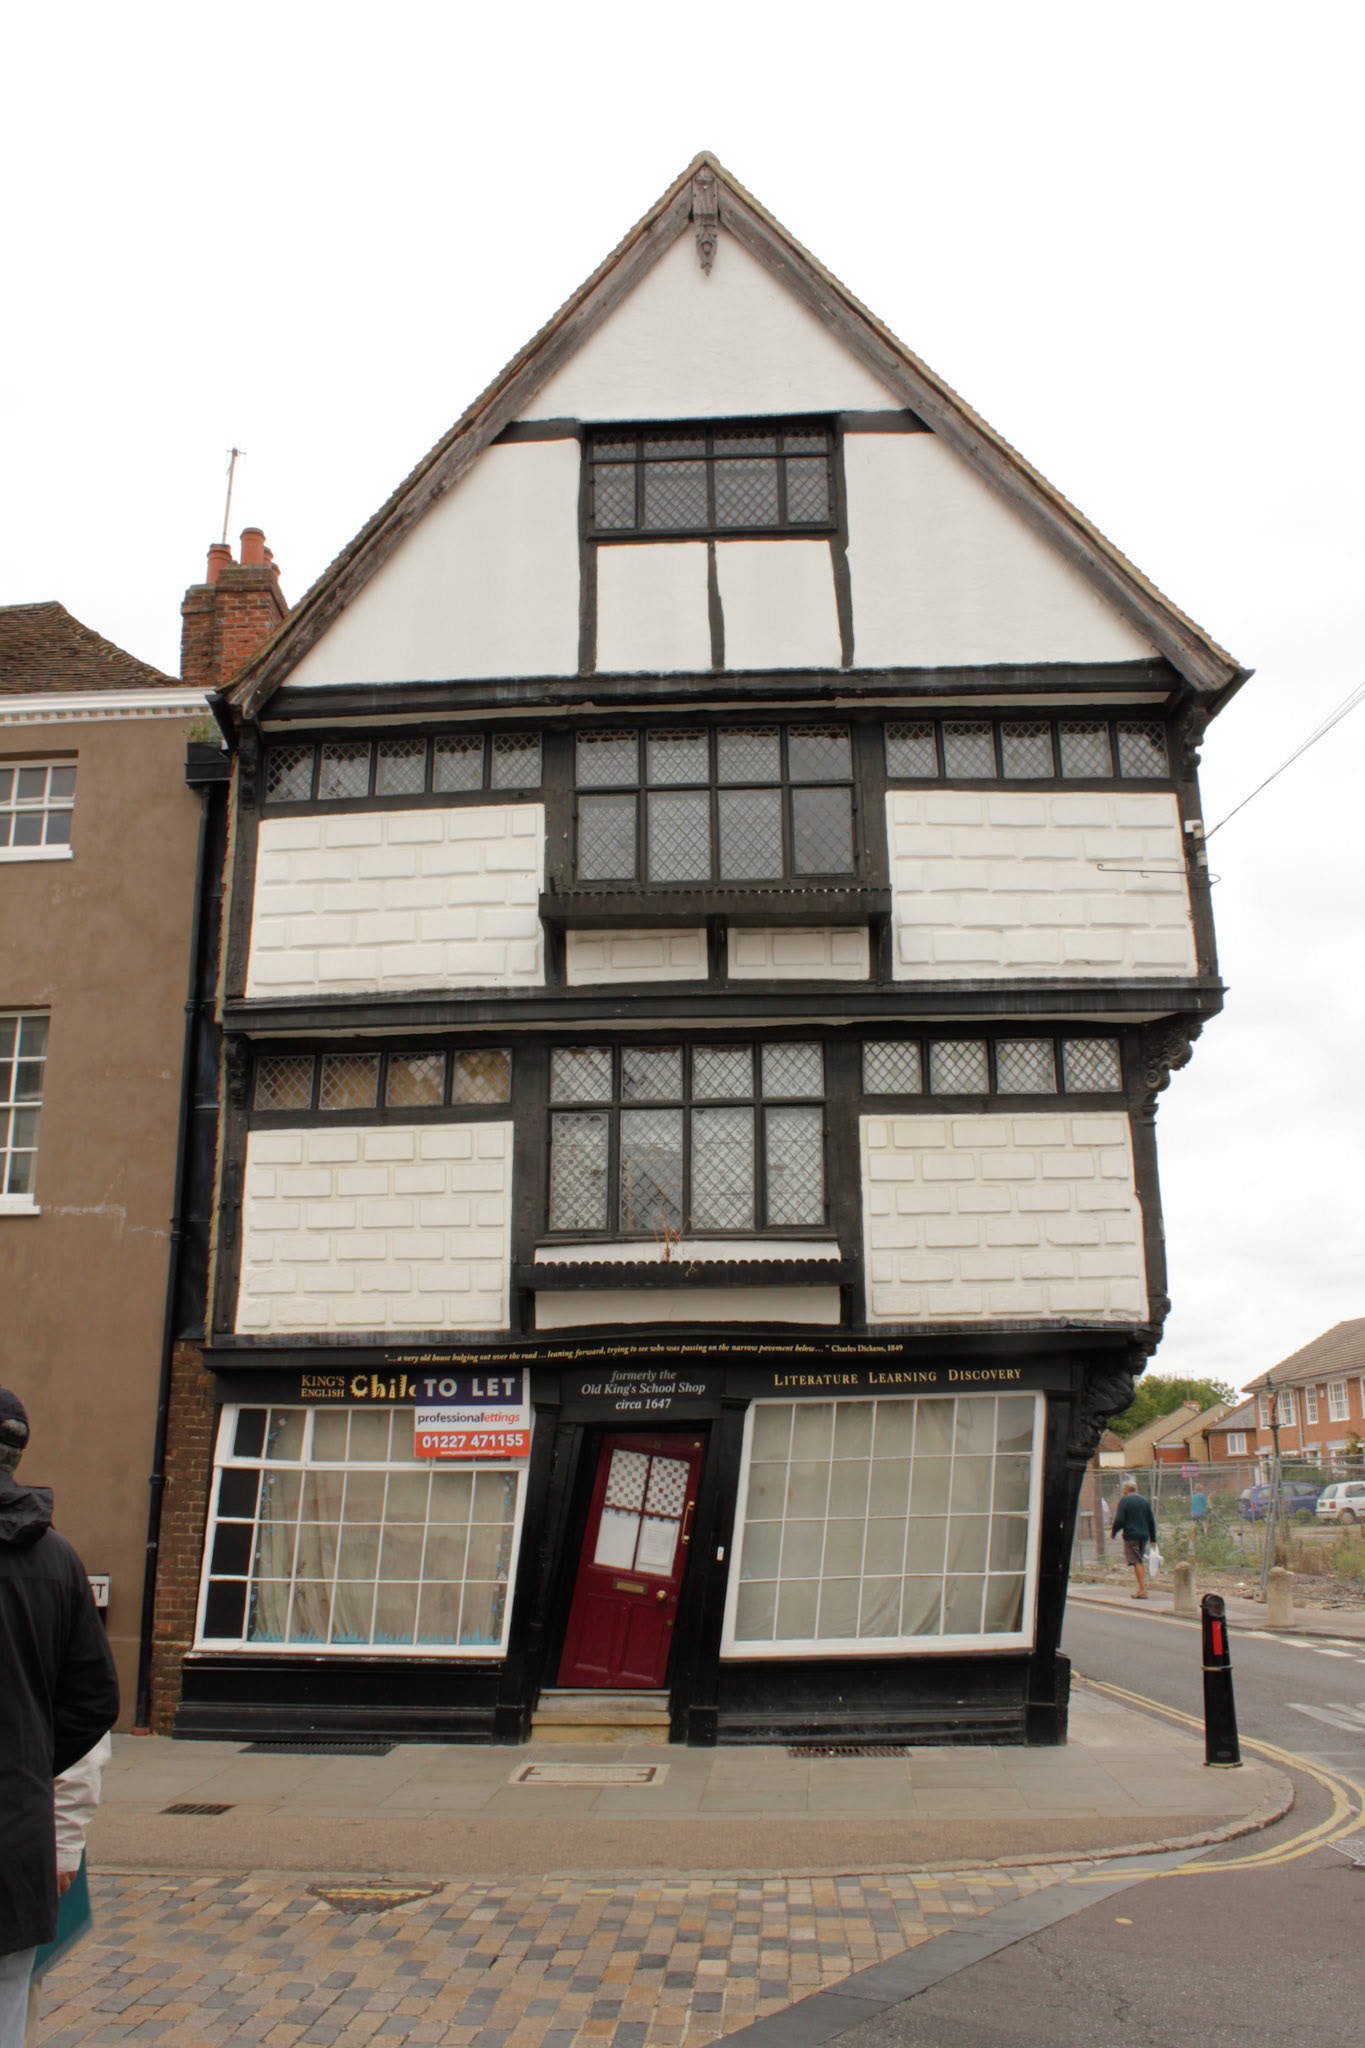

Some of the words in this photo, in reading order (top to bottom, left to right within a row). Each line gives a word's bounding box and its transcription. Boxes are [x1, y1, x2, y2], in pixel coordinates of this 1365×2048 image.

[403, 1355, 418, 1364] very
[420, 1353, 431, 1362] old
[432, 1353, 450, 1361] house
[452, 1352, 478, 1363] bulging
[480, 1353, 491, 1361] out
[509, 1351, 520, 1360] the
[521, 1350, 538, 1360] road
[547, 1350, 573, 1359] leaning
[574, 1347, 606, 1358] forward,
[607, 1346, 629, 1355] trying
[650, 1344, 664, 1352] who
[681, 1344, 707, 1354] passing
[718, 1343, 730, 1351] the
[758, 1345, 793, 1354] pavement
[858, 1345, 887, 1353] Dickens,
[887, 1344, 903, 1352] 1849
[610, 1370, 657, 1383] formerly
[660, 1369, 677, 1380] the
[774, 1374, 859, 1386] LITERATURE
[868, 1371, 937, 1384] LEARNING
[948, 1368, 1022, 1381] DISCOVERY
[301, 1388, 345, 1398] ENGLISH
[424, 1378, 458, 1397] TO
[472, 1377, 515, 1396] LET
[581, 1383, 601, 1395] Old
[604, 1383, 636, 1396] King's
[639, 1382, 676, 1394] School
[678, 1382, 706, 1395] Shop
[615, 1399, 642, 1410] circa
[645, 1398, 672, 1409] 1647
[422, 1435, 467, 1449] 01227
[470, 1433, 524, 1448] 471155
